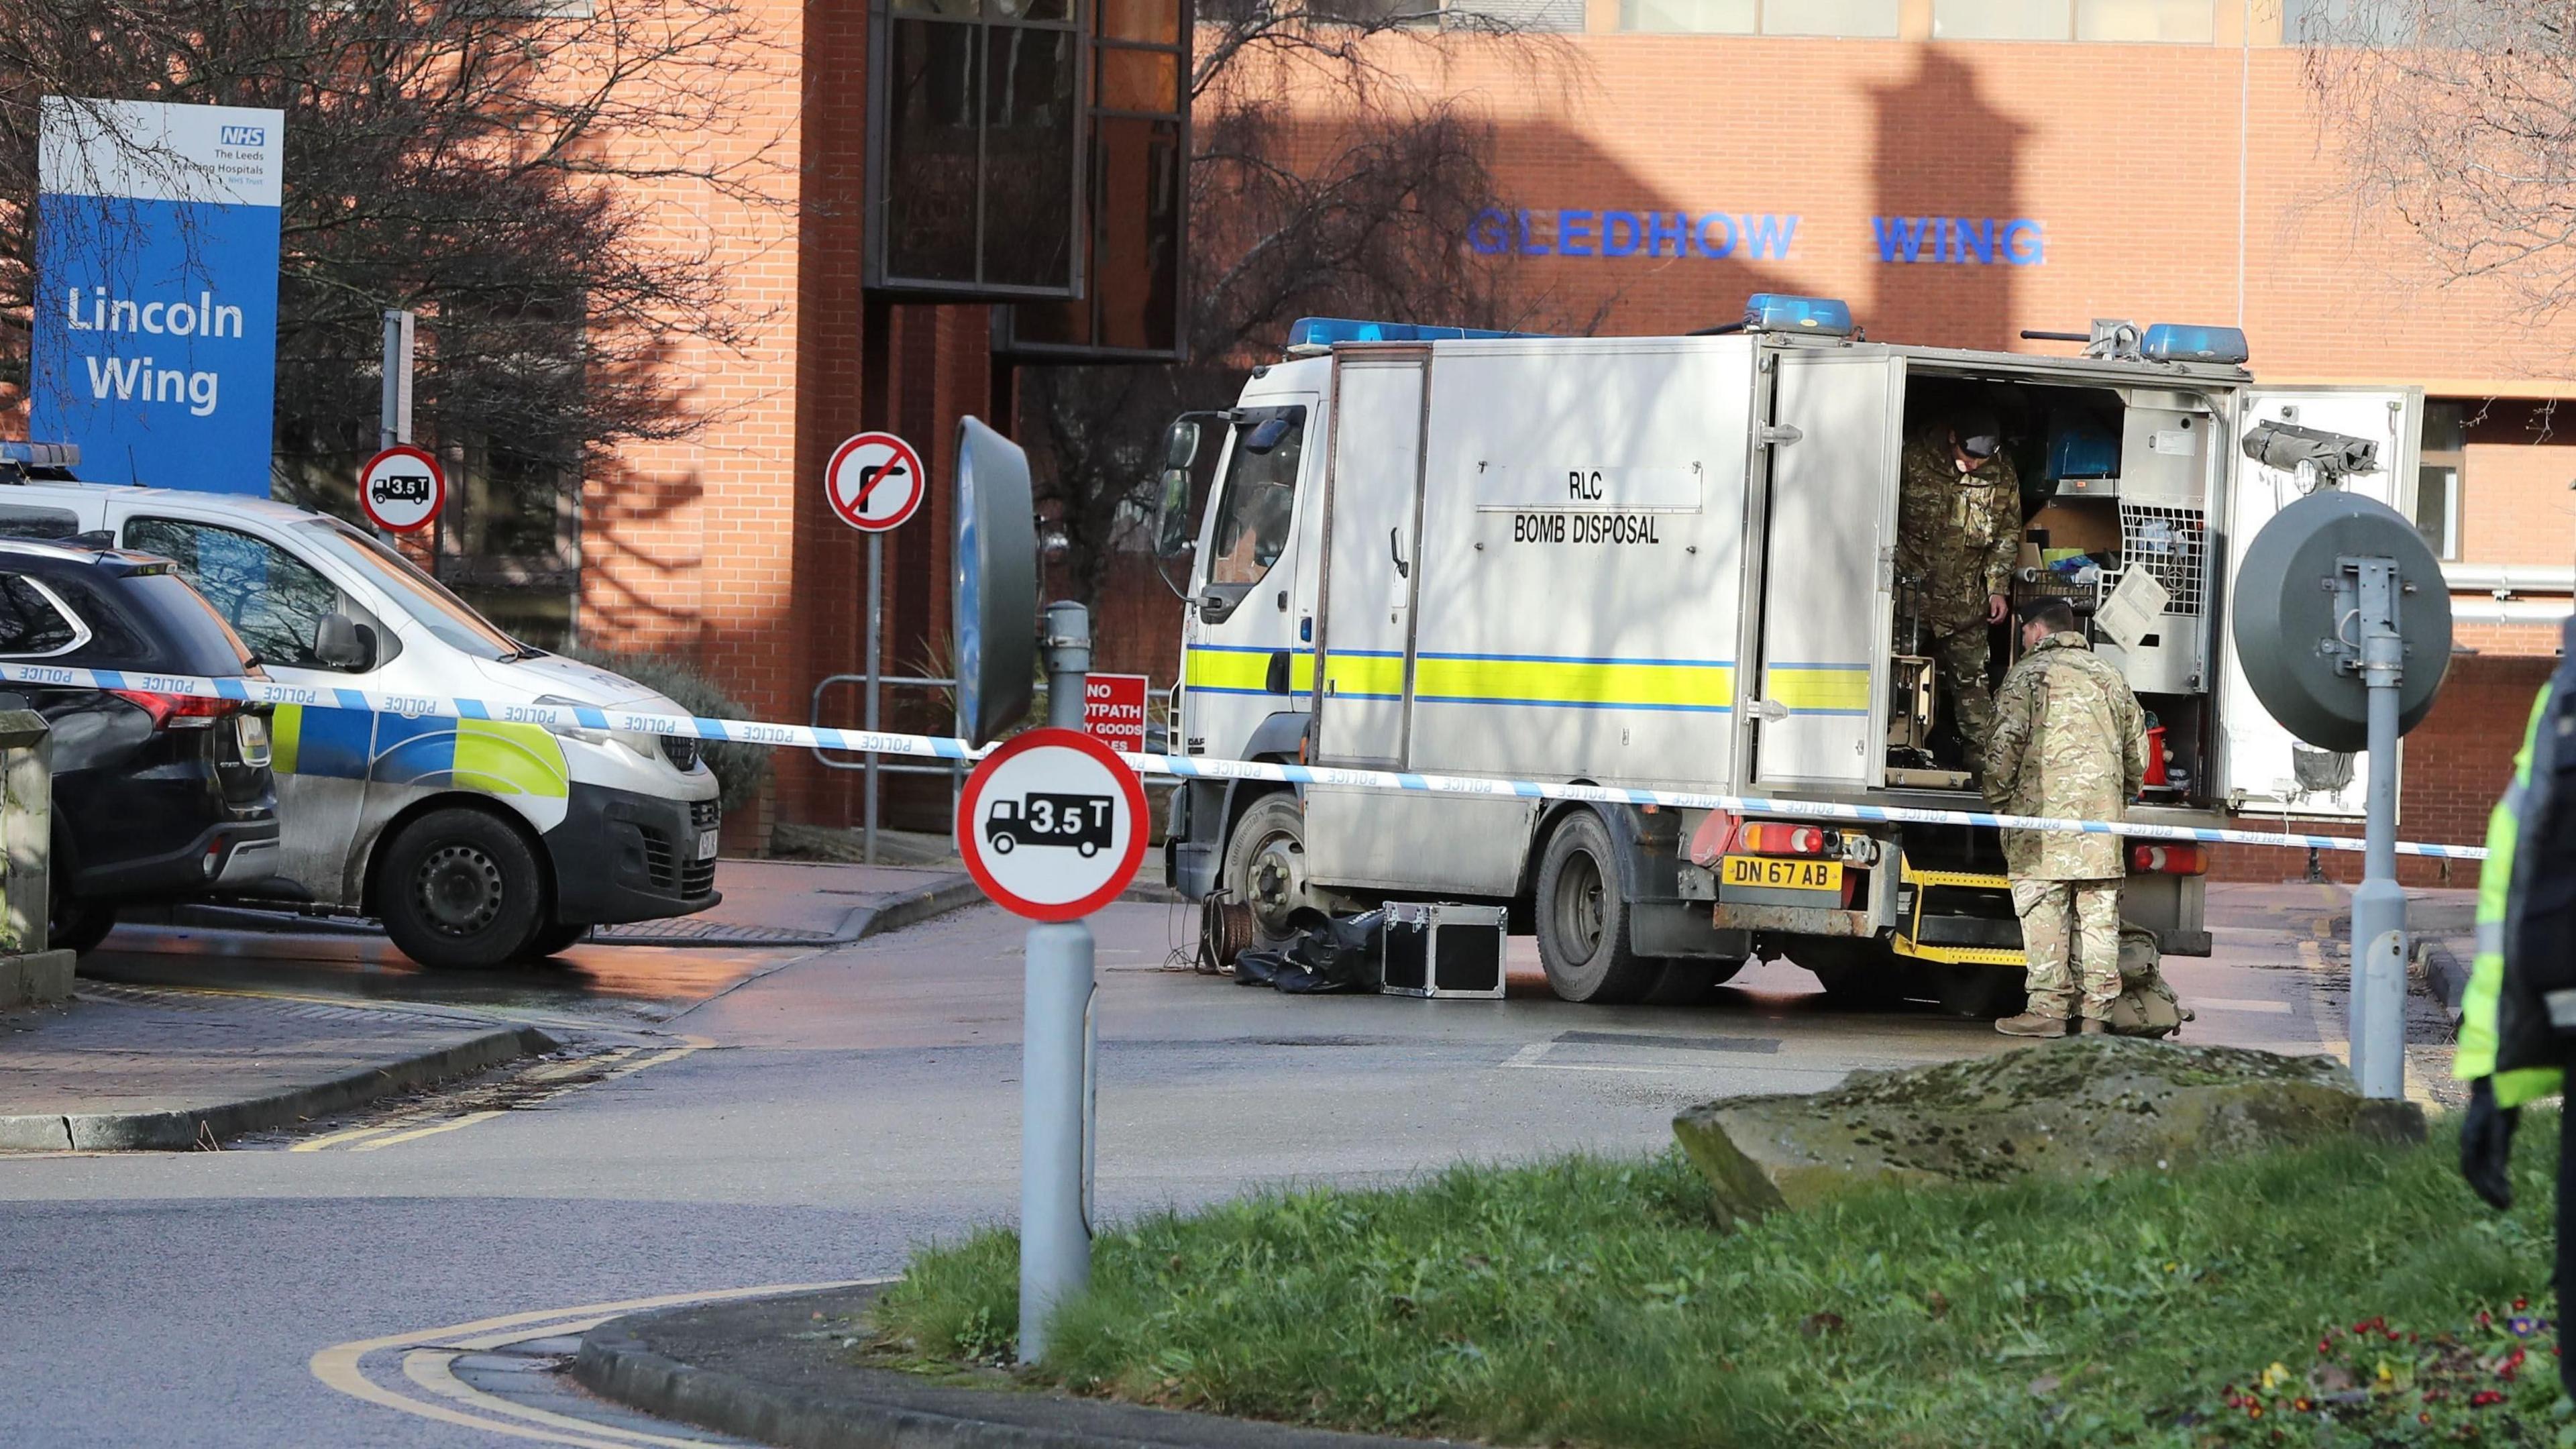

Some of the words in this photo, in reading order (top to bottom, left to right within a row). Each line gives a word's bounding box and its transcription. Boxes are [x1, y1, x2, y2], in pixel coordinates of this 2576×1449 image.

[221, 127, 263, 145] NHS
[215, 150, 233, 159] The
[236, 151, 264, 160] Leeds
[218, 164, 263, 175] Hospitals
[1470, 209, 1797, 260] GLEDHOW
[1872, 216, 2043, 264] WING
[68, 286, 242, 337] Lincoln
[86, 356, 218, 416] Wing
[1569, 471, 1603, 500] RLC
[1514, 515, 1565, 543] BOMB
[1573, 515, 1659, 544] DISPOSAL
[1087, 684, 1111, 698] NO
[1096, 723, 1142, 735] GOODS
[19, 667, 72, 683] POLICE
[142, 677, 195, 693] POLICE
[264, 686, 316, 703] POLICE
[384, 696, 436, 713] POLICE
[505, 706, 557, 724] POLICE
[625, 716, 675, 733] POLICE
[743, 726, 794, 743] POLICE
[861, 736, 912, 752] POLICE
[1213, 761, 1261, 778] POLICE
[1328, 770, 1377, 786] POLICE
[1443, 778, 1492, 793] POLICE
[1558, 786, 1607, 800] POLICE
[1673, 795, 1721, 807] POLICE
[1785, 802, 1835, 814] POLICE
[2013, 816, 2061, 828] POLICE
[1735, 861, 1762, 881] DN
[1769, 863, 1795, 883] 67
[1802, 864, 1827, 885] AB
